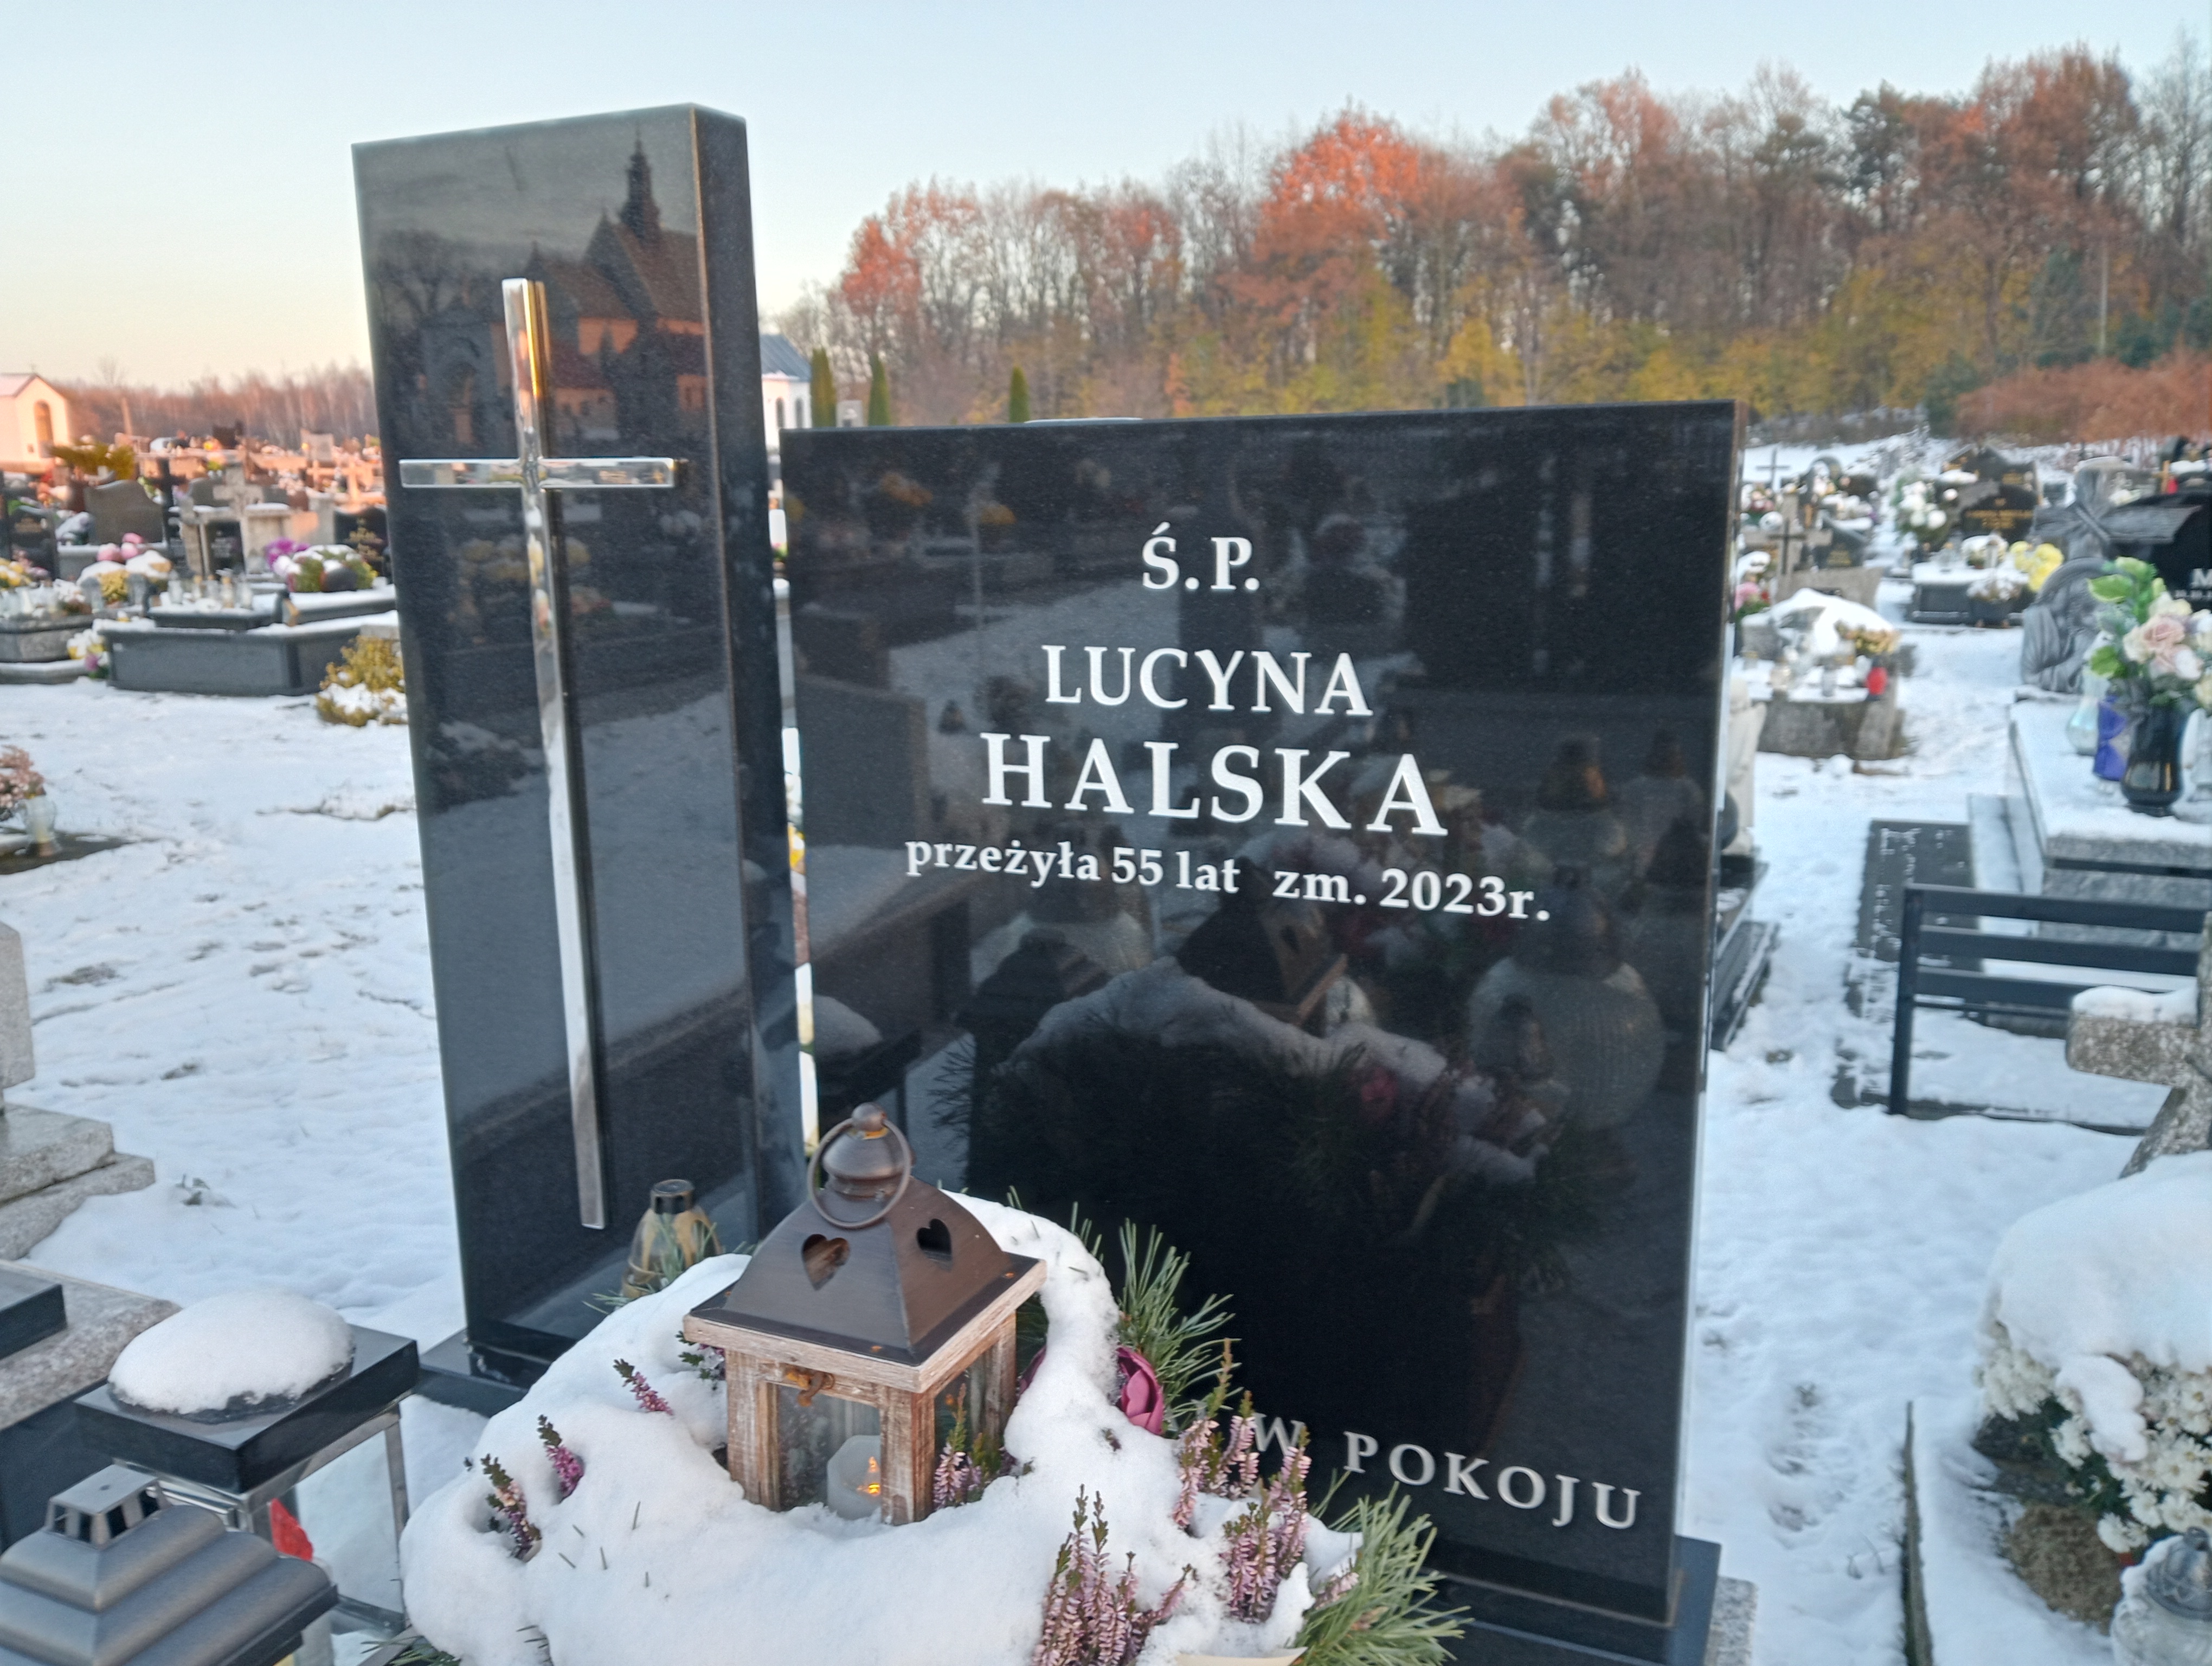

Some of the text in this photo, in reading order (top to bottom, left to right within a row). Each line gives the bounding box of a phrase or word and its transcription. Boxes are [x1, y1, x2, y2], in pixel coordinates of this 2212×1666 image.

[1040, 644, 1374, 716] LUCYNA
[979, 732, 1449, 836] HALSKA
[904, 839, 1551, 921] przeżyła 55 lat zm. 2023r.
[1252, 1412, 1306, 1457] W
[1343, 1430, 1641, 1529] POKOJU
